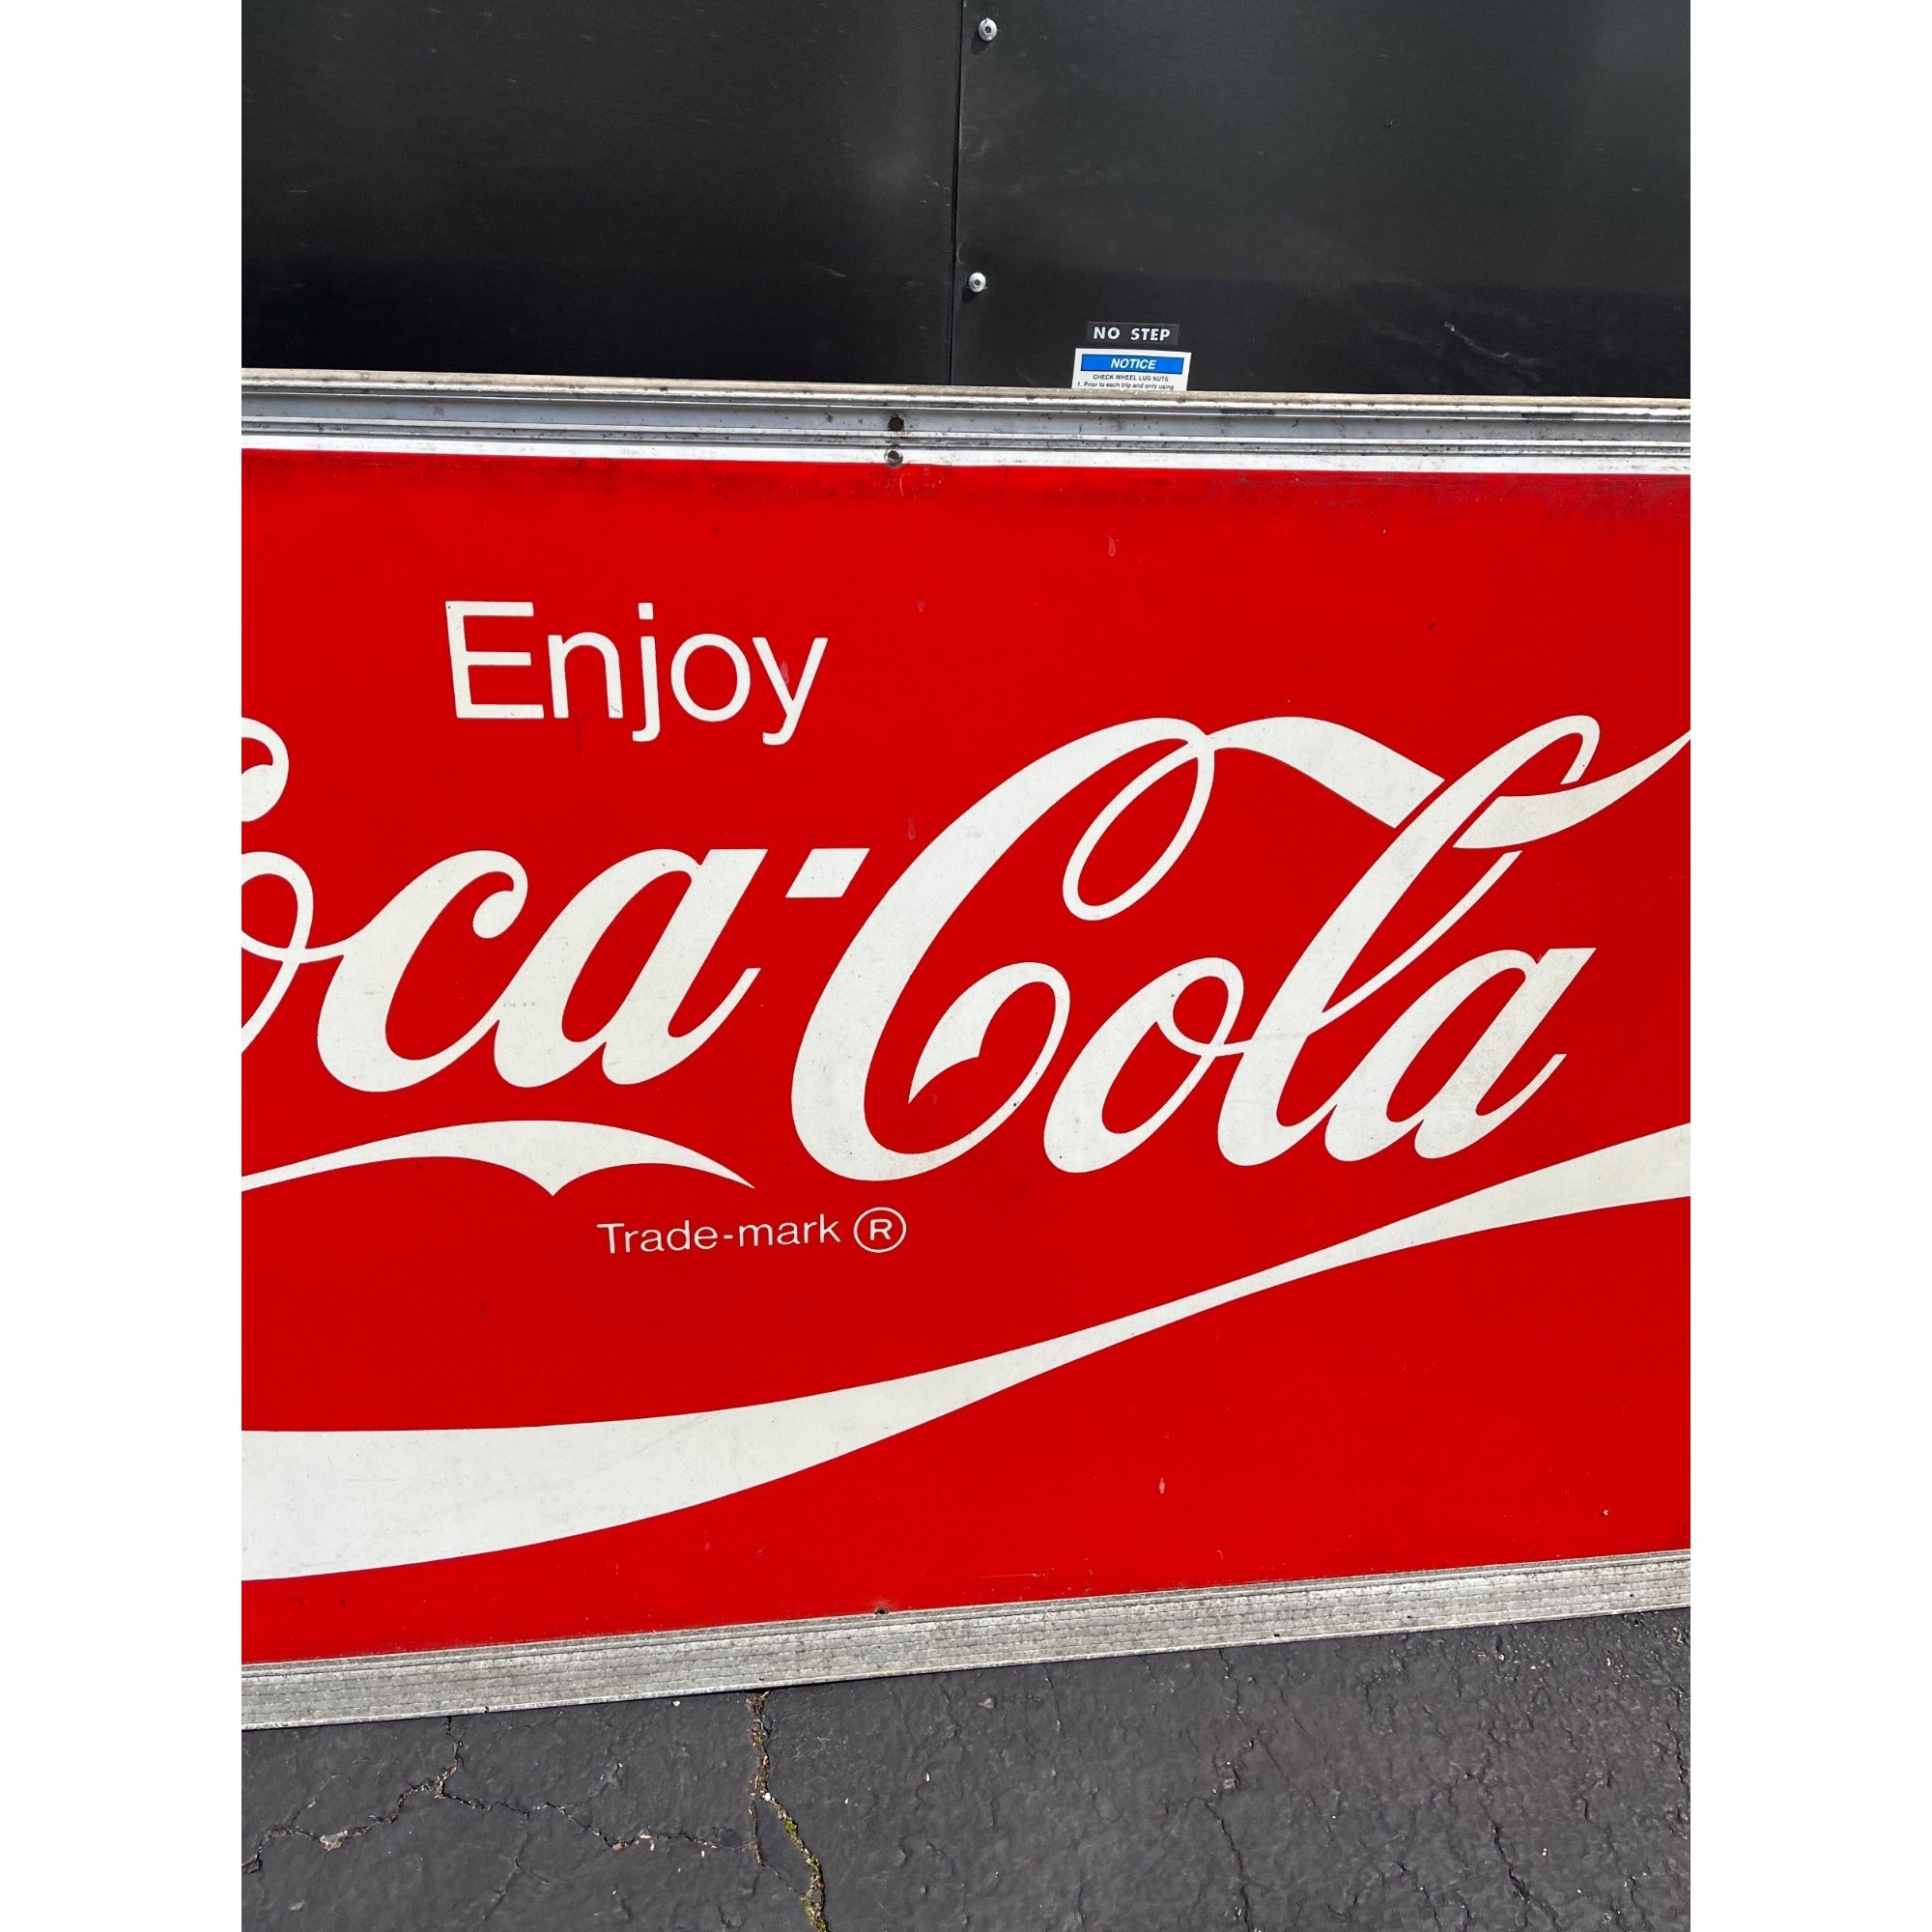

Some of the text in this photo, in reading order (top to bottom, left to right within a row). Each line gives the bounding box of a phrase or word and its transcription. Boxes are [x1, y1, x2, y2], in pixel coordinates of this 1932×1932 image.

[1093, 326, 1171, 341] NO STEP
[1110, 357, 1157, 370] NOTICE
[445, 601, 828, 745] Enjoy
[242, 716, 1600, 1180] ca-Cola
[597, 1214, 840, 1254] Trade-mark
